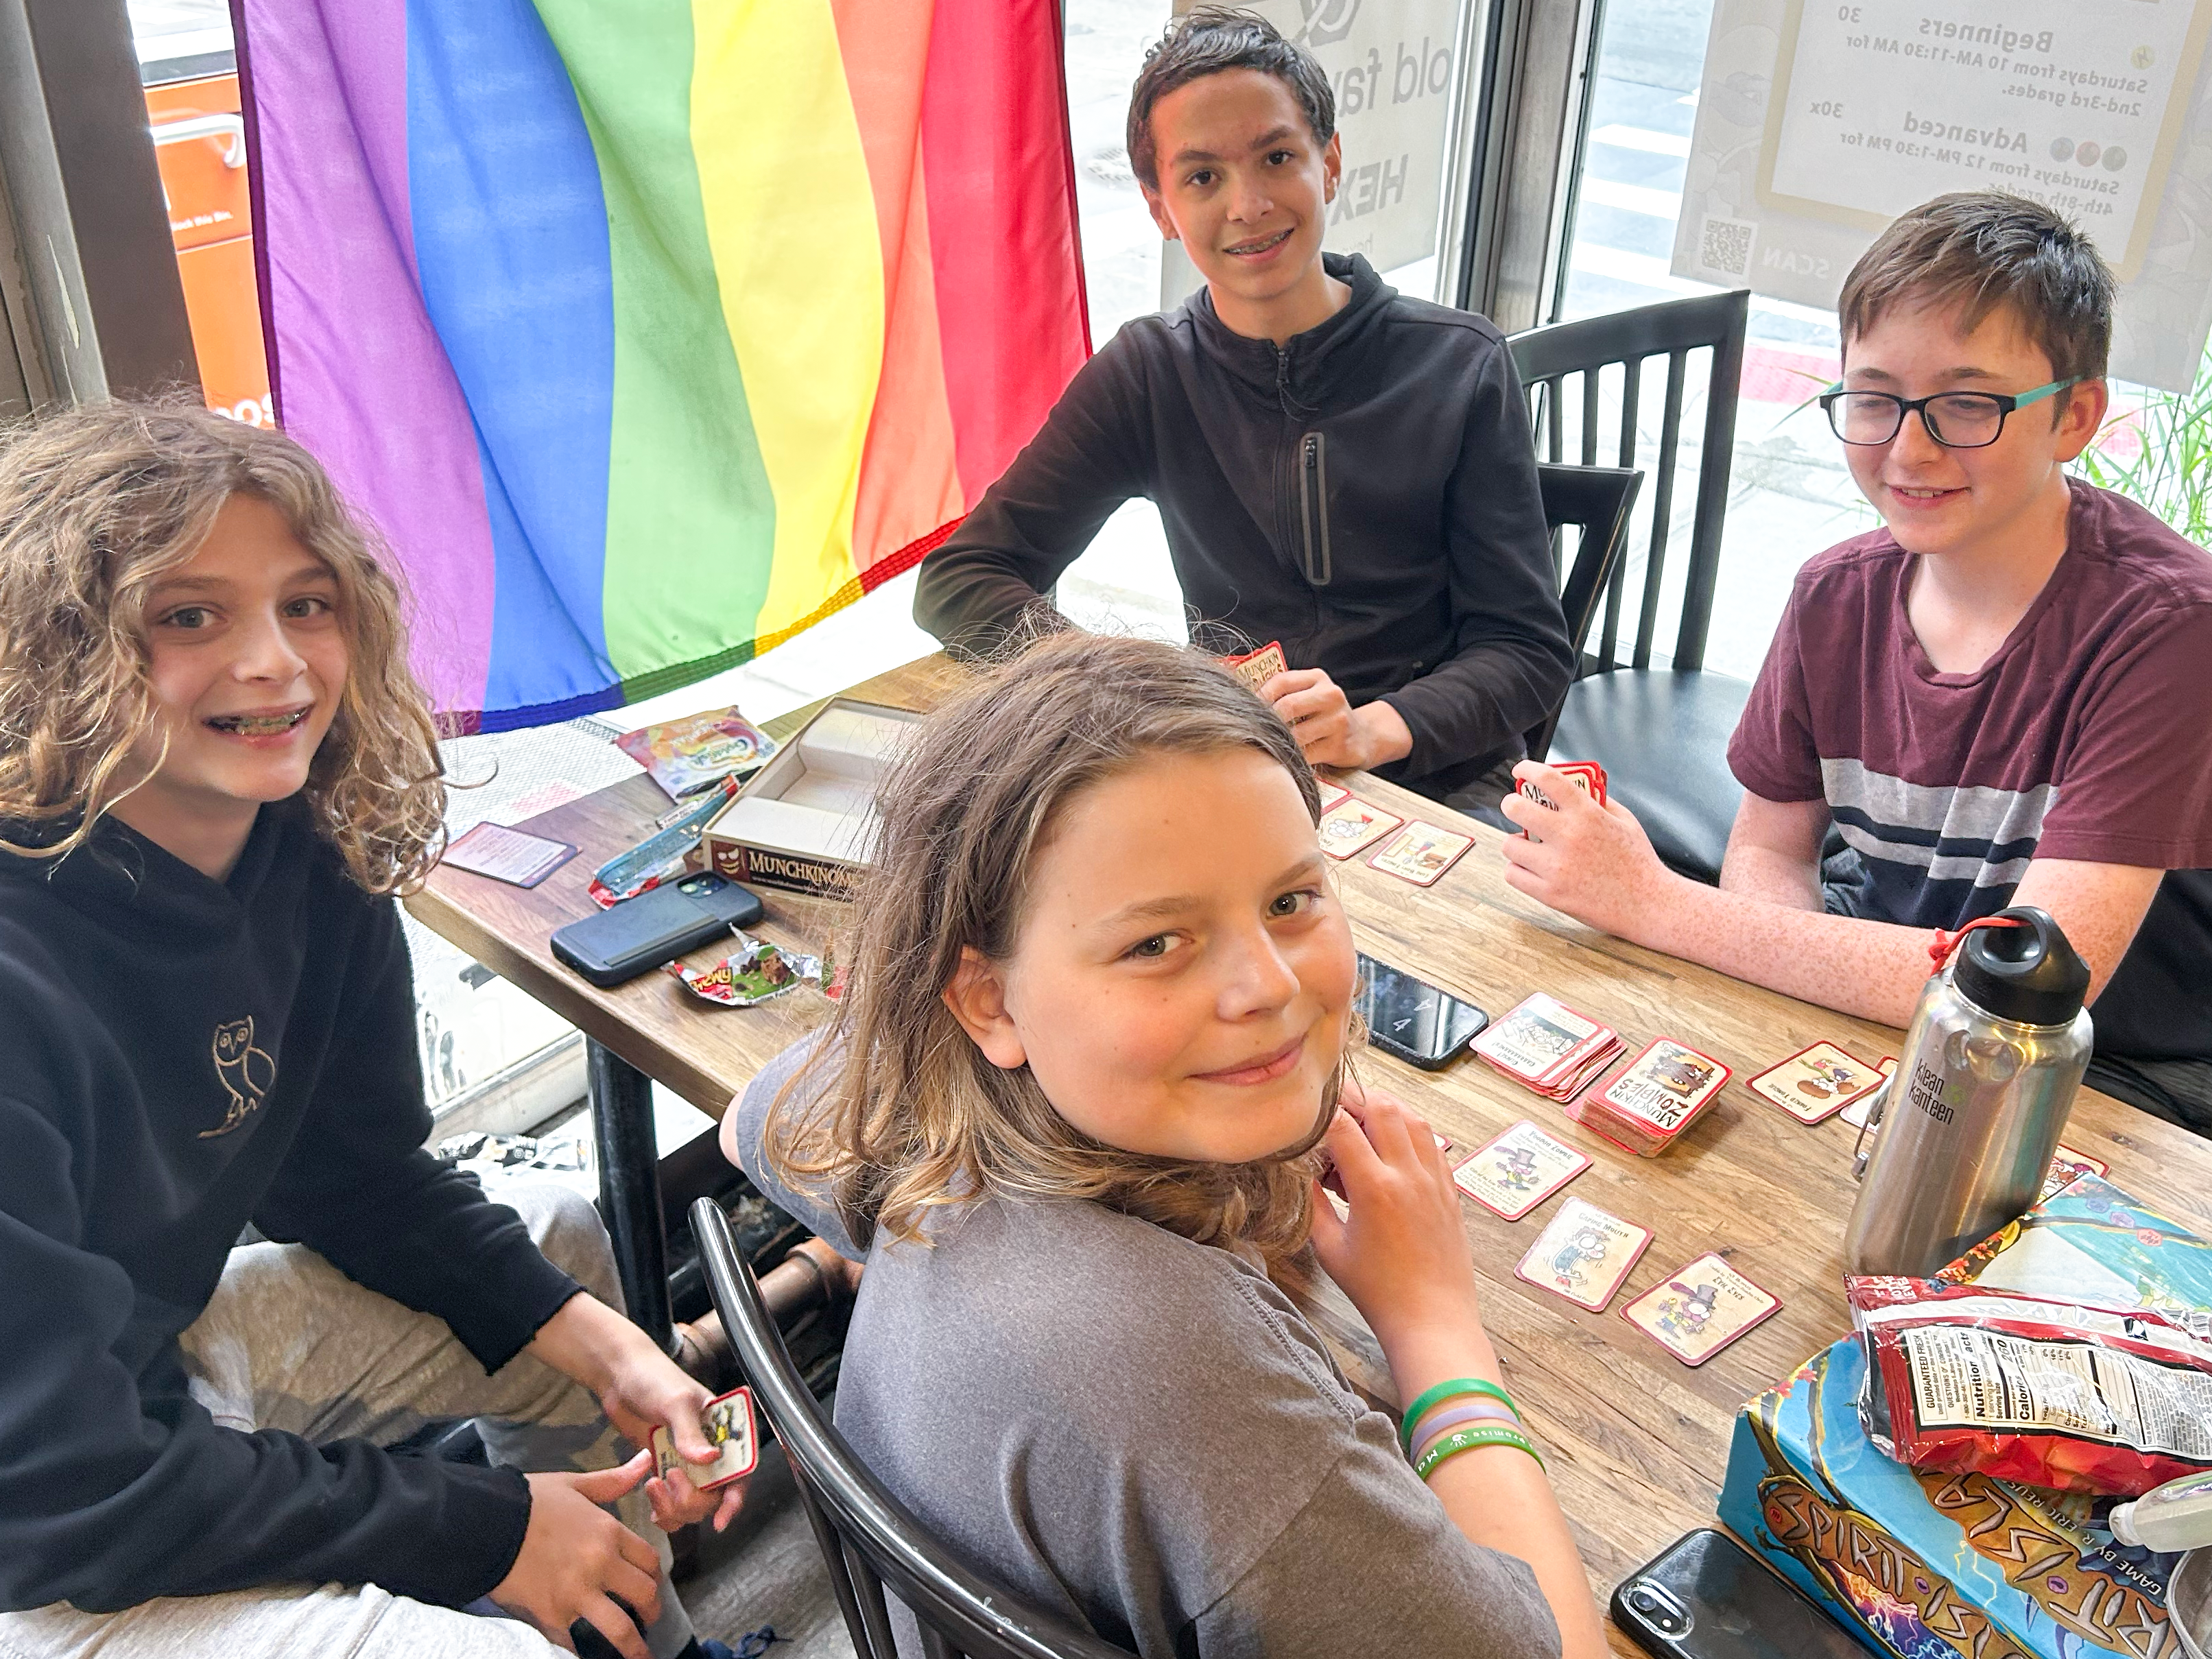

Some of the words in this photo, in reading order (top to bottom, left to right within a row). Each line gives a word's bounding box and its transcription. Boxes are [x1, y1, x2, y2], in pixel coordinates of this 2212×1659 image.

[1916, 1059, 1945, 1095] klean
[1610, 1089, 1678, 1128] MUNCHKIN
[1620, 1077, 1688, 1117] ZOMBIES
[1909, 1079, 1954, 1125] kanteen
[1603, 1224, 1630, 1239] MOUTH
[1913, 1335, 1926, 1354] FRESH
[1959, 1332, 1973, 1353] acts
[1997, 1339, 2014, 1363] 260
[1918, 1356, 1936, 1408] GUARANTEED
[1942, 1374, 1954, 1408] QUESTIONS
[1969, 1361, 1986, 1418] Nutrition
[1986, 1388, 1995, 1413] serving
[1994, 1396, 2005, 1419] Serving
[2014, 1375, 2031, 1420] Calories
[1418, 1448, 1438, 1472] Ma
[2045, 1507, 2078, 1533] ERIC
[1774, 1493, 1923, 1597] SPIRIT
[2078, 1530, 2095, 1547] R.
[2092, 1542, 2117, 1563] BY
[2116, 1559, 2163, 1596] GAME
